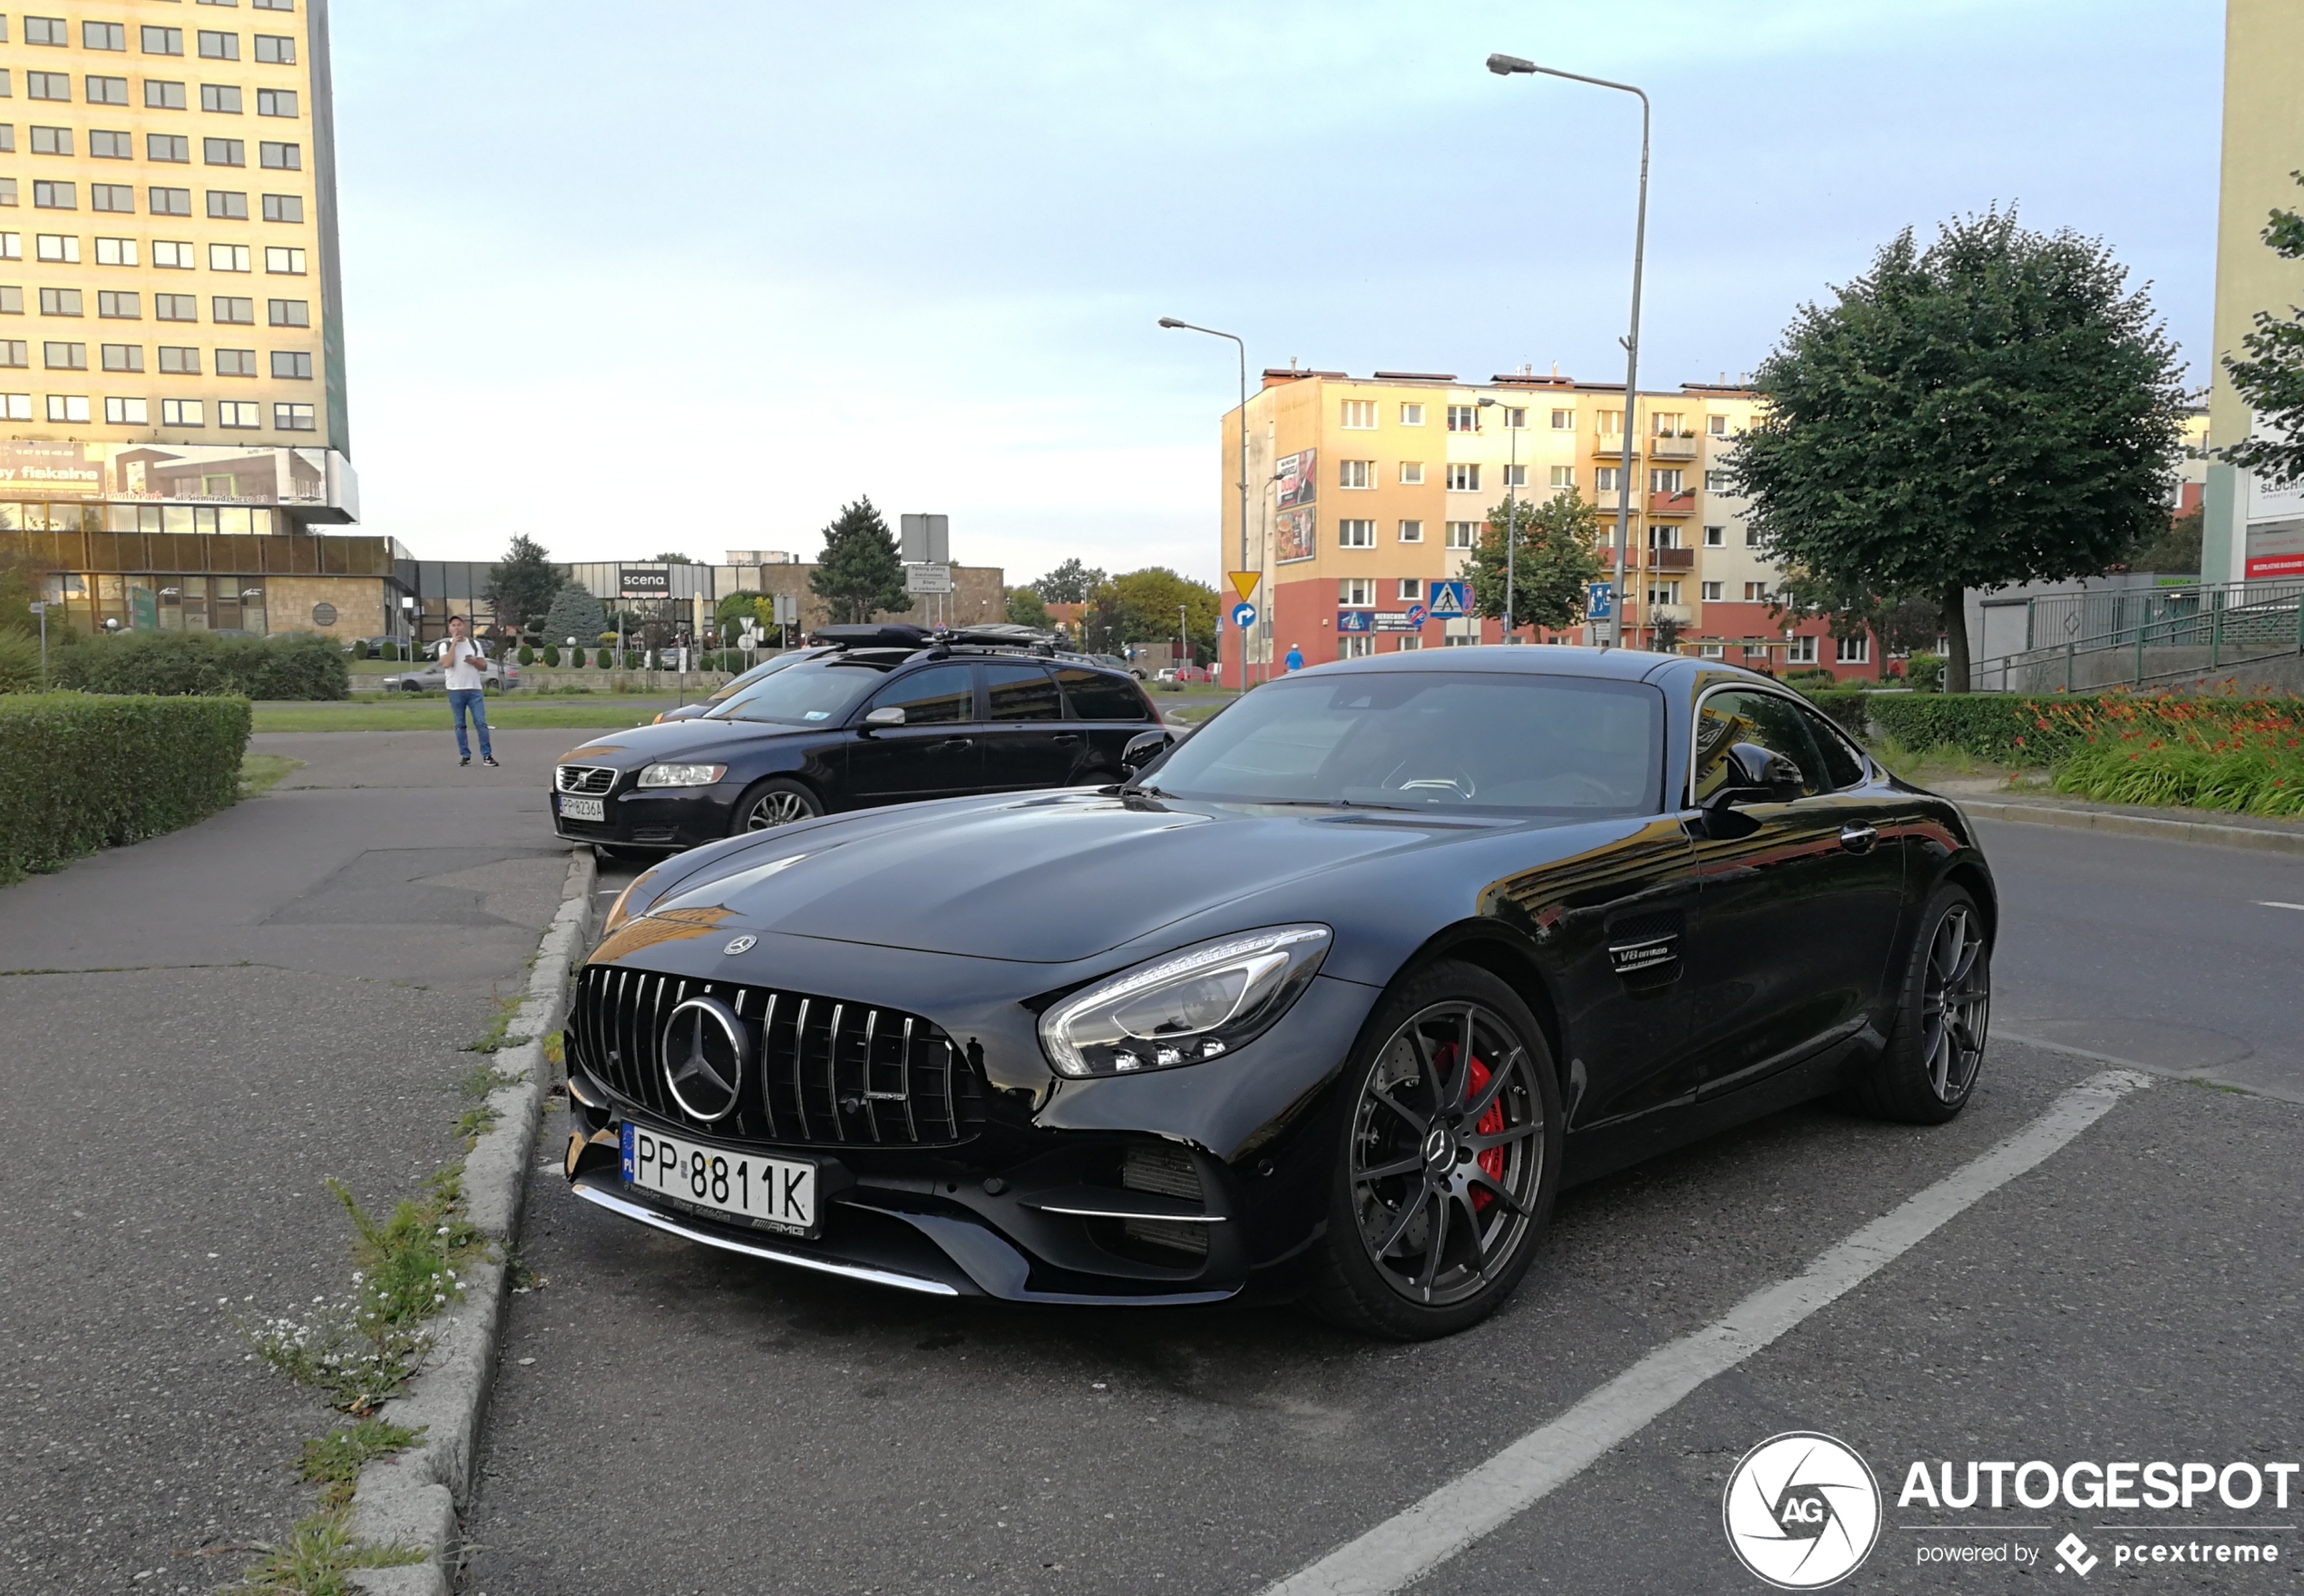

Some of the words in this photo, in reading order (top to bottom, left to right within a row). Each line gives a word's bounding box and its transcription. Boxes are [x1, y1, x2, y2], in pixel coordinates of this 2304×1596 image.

[21, 465, 98, 481] fiskalne
[139, 490, 163, 500] Park
[188, 493, 254, 503] Siemiradzkiego
[575, 800, 602, 817] 8236A
[1620, 949, 1638, 962] V8
[624, 1158, 633, 1173] PL
[639, 1134, 677, 1187] PP
[691, 1151, 807, 1221] 8811K
